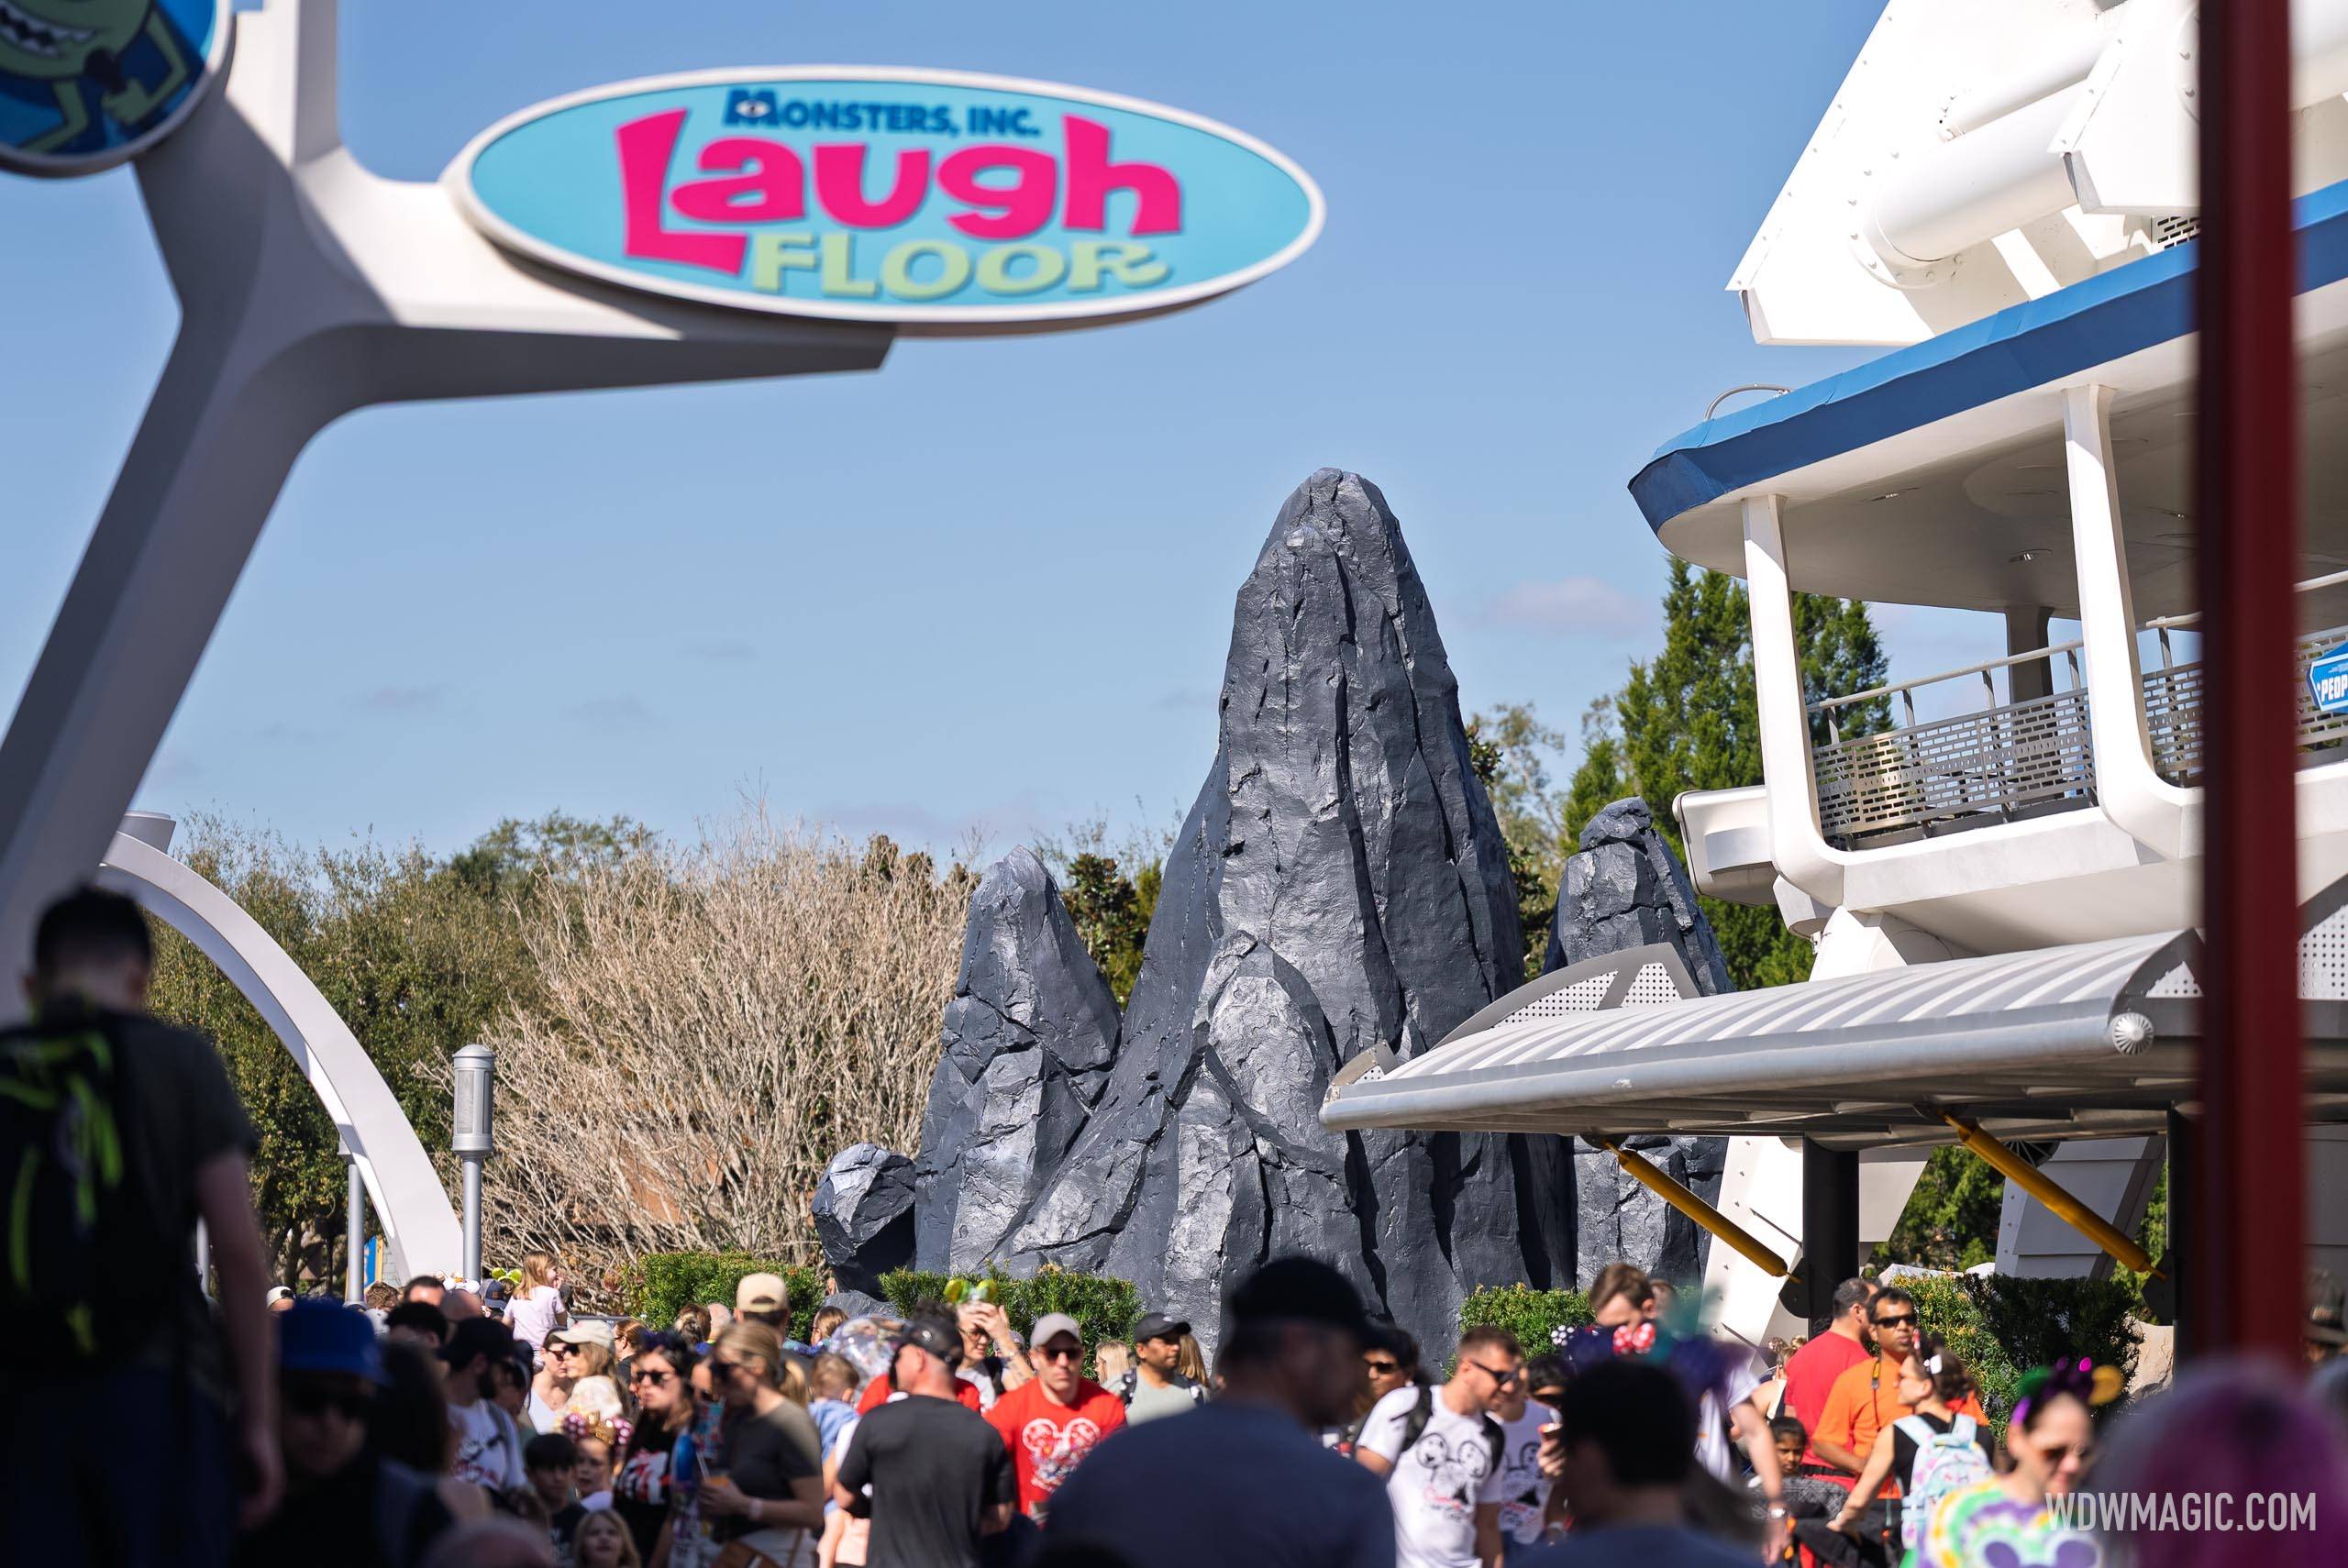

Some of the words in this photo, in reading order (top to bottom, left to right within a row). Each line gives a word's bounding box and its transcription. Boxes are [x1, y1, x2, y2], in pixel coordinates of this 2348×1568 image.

[722, 88, 961, 137] MONSTERS,
[967, 105, 1042, 137] INC.
[614, 106, 1183, 276] Laugh
[750, 231, 1171, 301] FLOOR
